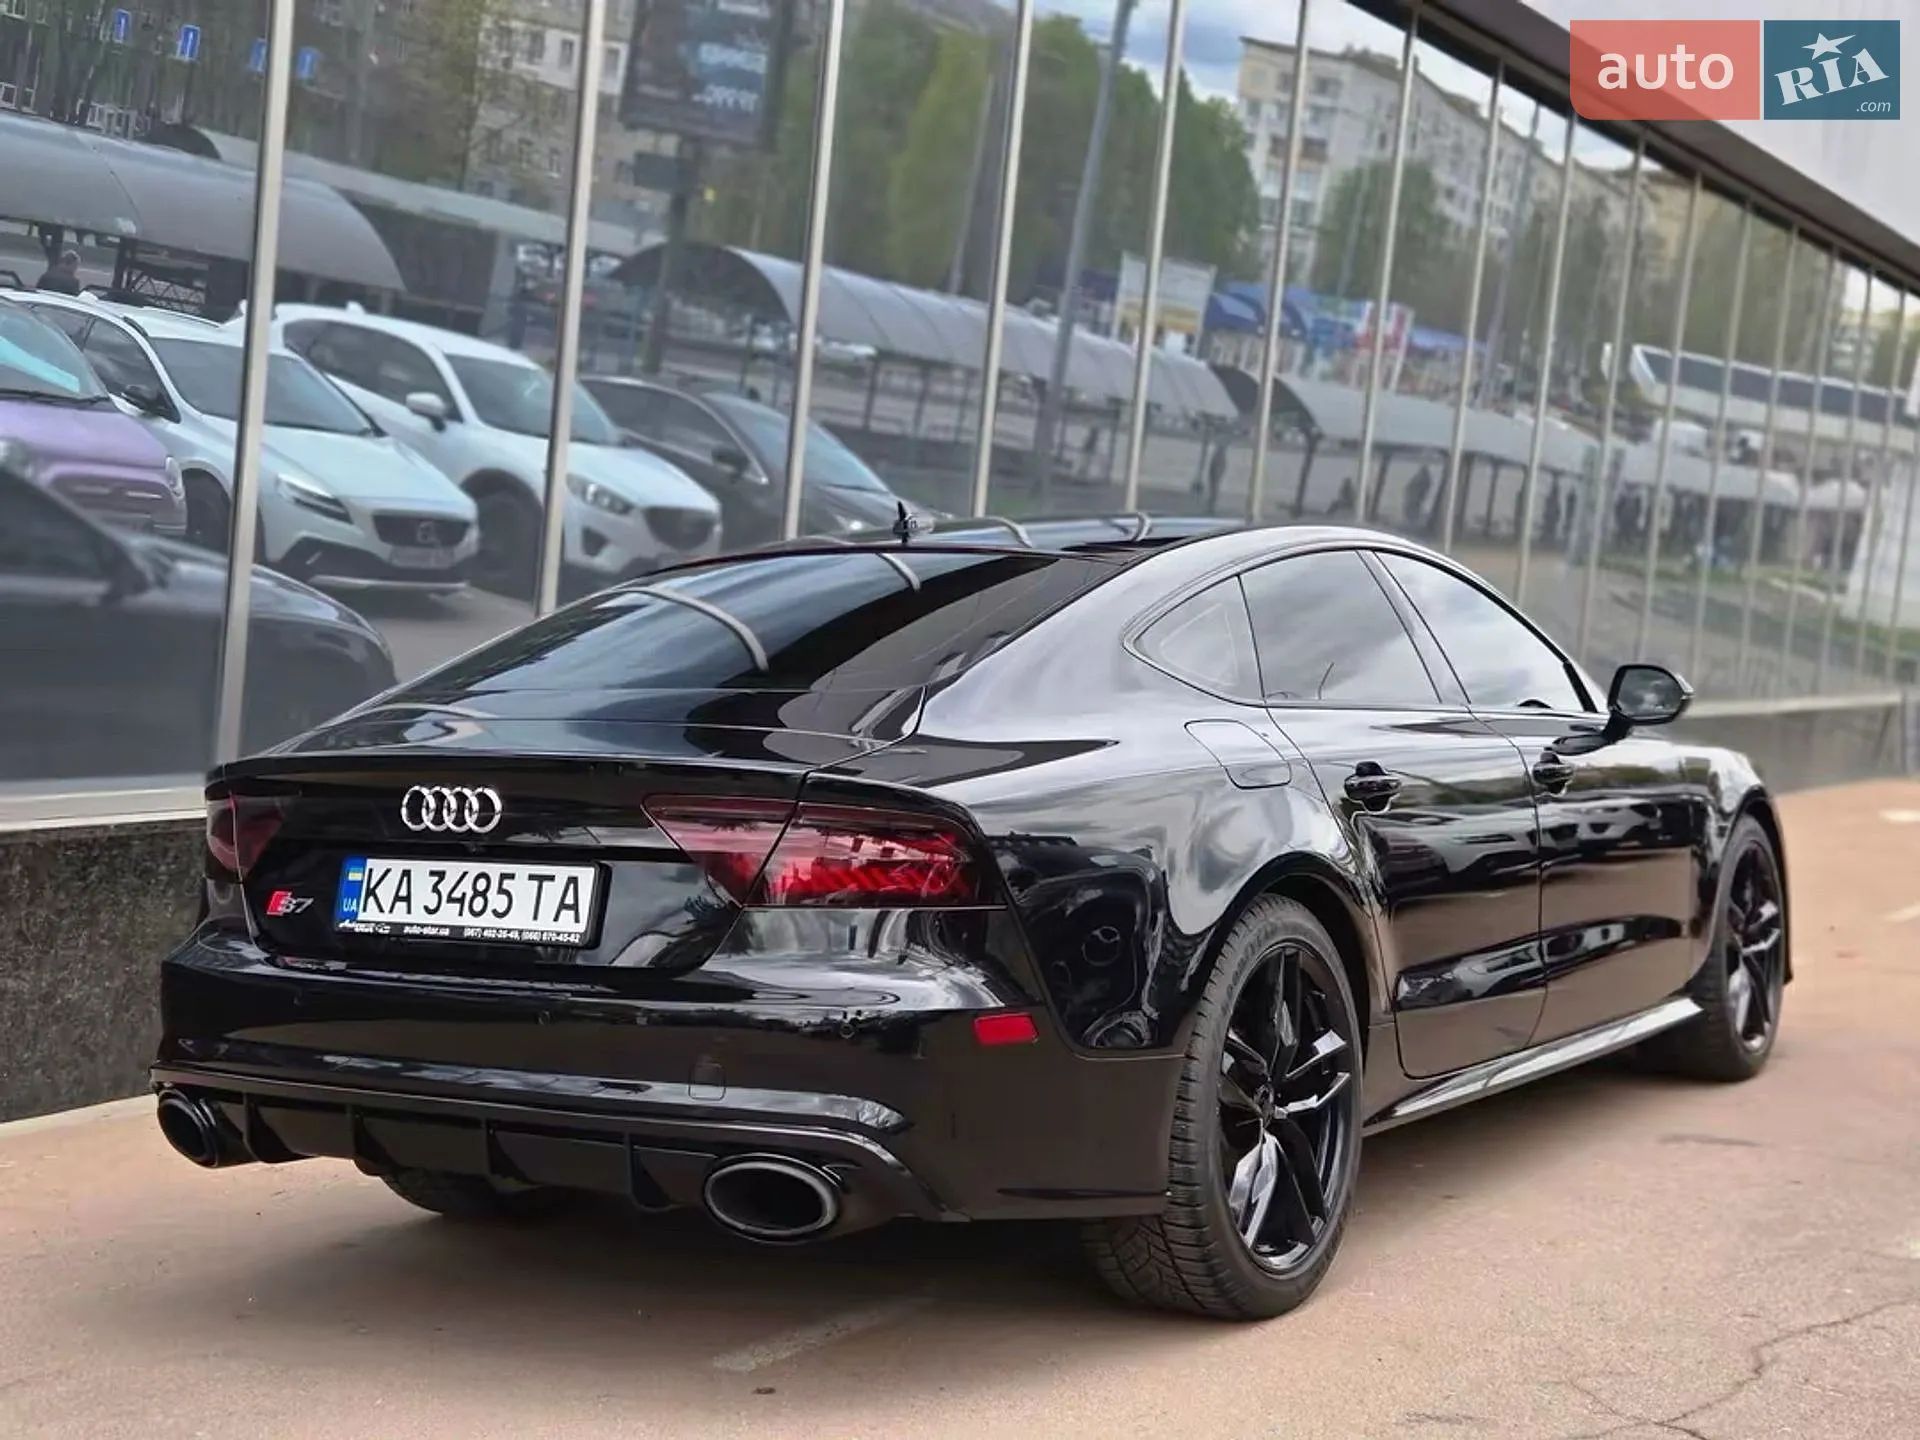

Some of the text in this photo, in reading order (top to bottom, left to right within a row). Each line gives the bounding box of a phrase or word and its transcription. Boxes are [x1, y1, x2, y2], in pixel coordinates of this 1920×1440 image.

[343, 897, 357, 912] UA
[362, 868, 581, 924] KA 3485 TA
